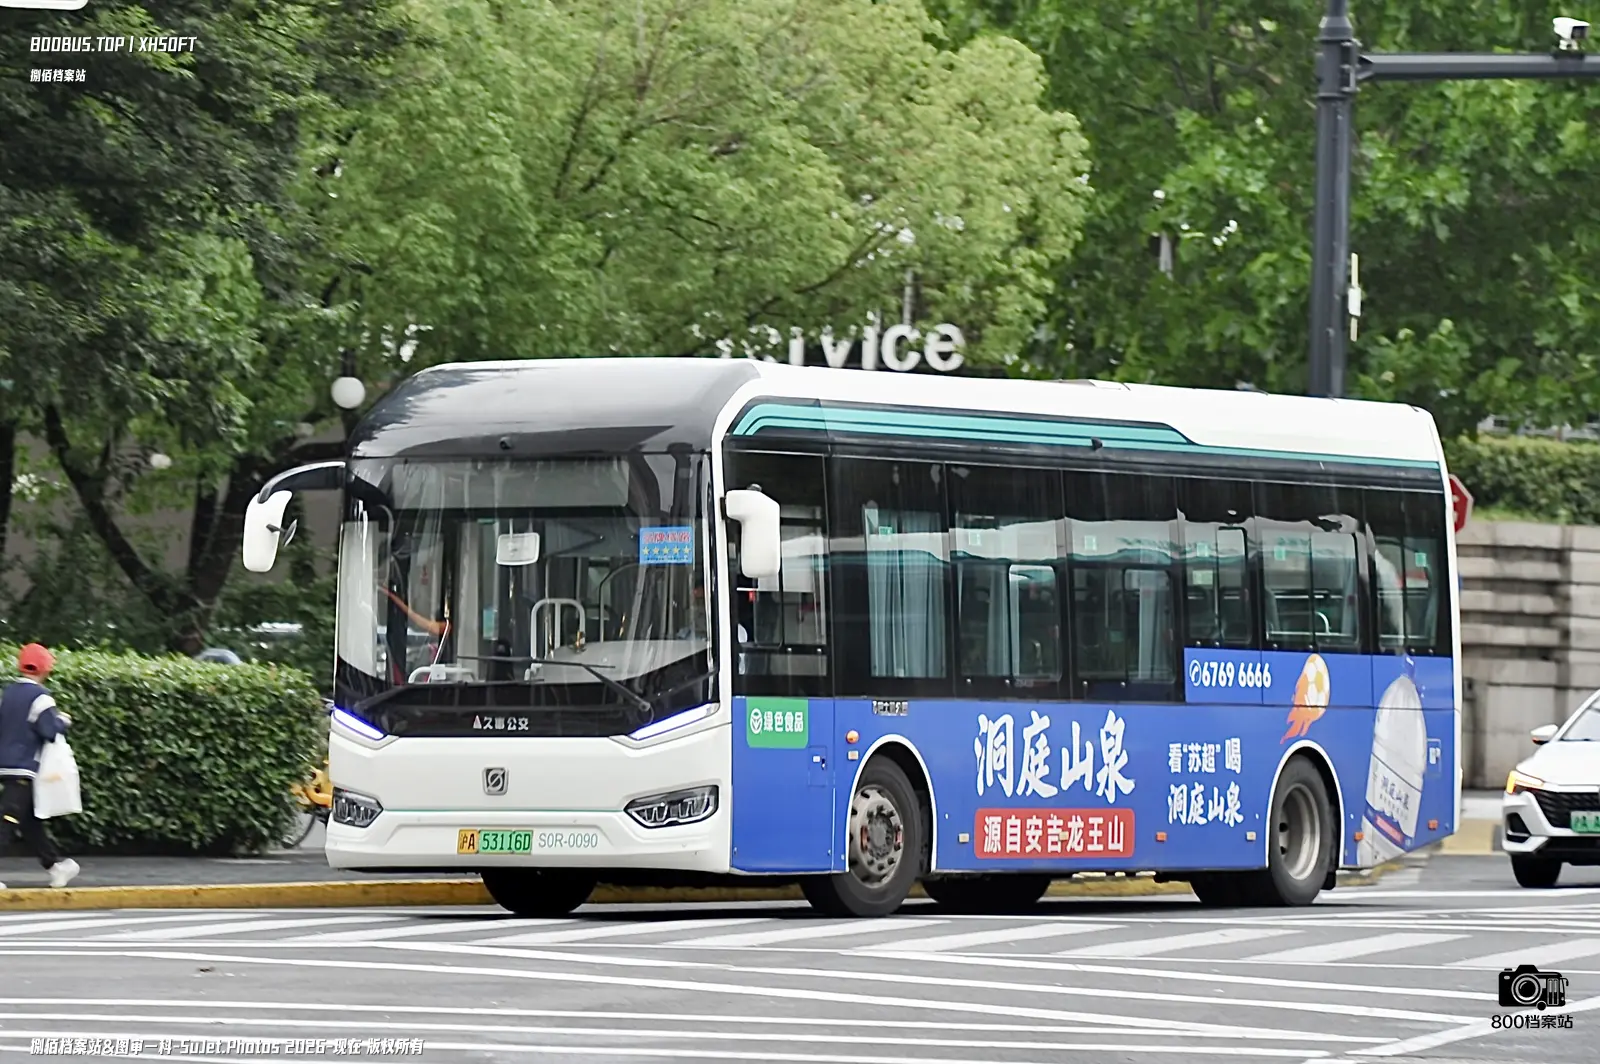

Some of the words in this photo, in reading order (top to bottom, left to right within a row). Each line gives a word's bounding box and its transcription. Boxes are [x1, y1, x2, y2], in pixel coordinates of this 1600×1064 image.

[716, 323, 966, 371] rvice
[1201, 661, 1235, 687] 6769
[1238, 663, 1272, 688] 6666
[763, 710, 804, 733] 绿色食品
[974, 709, 1136, 804] 洞庭山泉
[1167, 781, 1244, 828] 洞庭山泉
[983, 814, 1125, 853] 源自安吉龙王山
